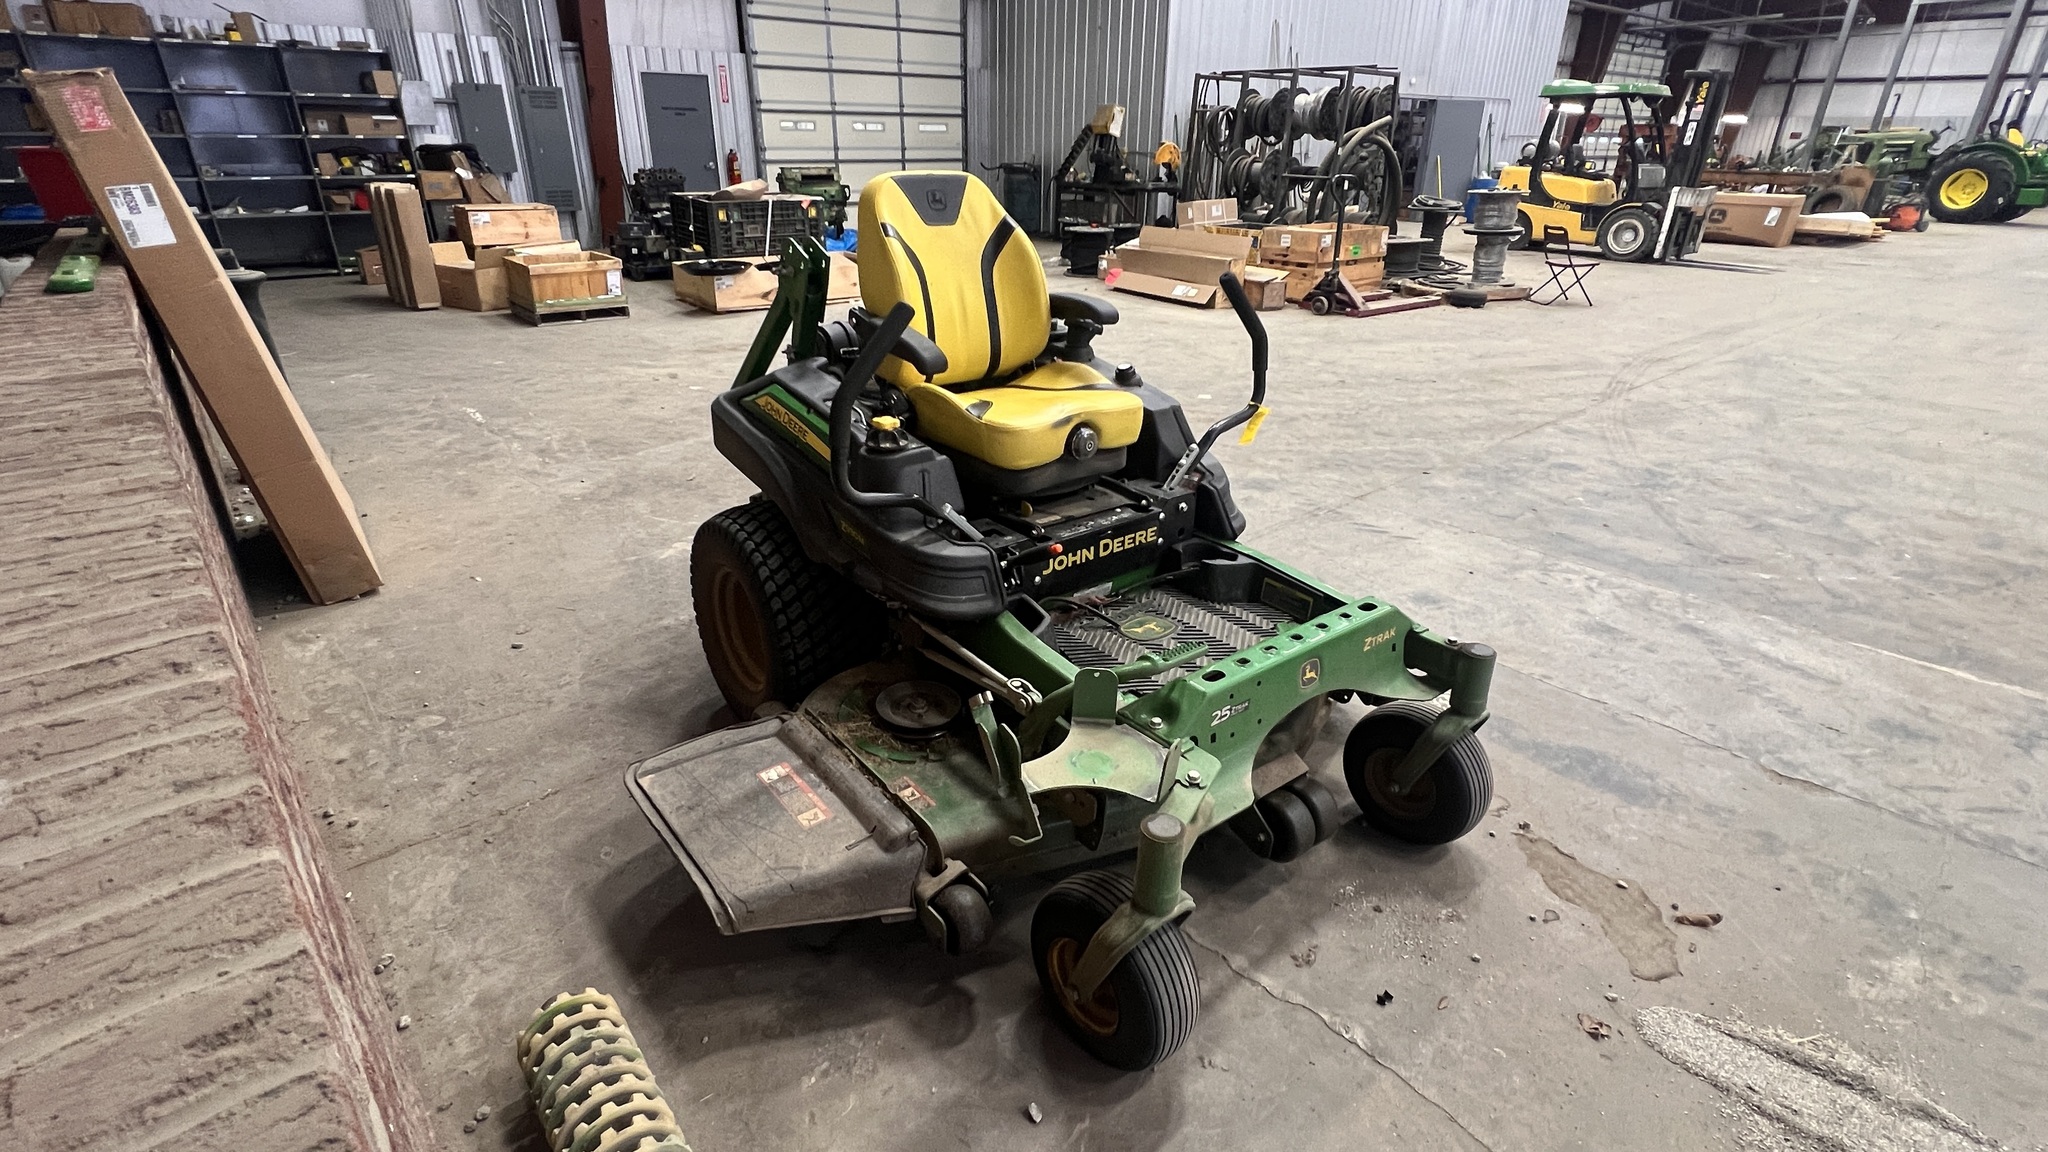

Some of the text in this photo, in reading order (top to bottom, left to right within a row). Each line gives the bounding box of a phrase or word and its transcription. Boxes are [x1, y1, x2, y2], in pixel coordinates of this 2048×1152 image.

[1552, 200, 1571, 211] Yale
[760, 398, 809, 443] JOHN DEERE
[1042, 526, 1158, 576] JOHN DEERE
[1363, 626, 1397, 652] ZTRAK
[1210, 704, 1231, 727] 25
